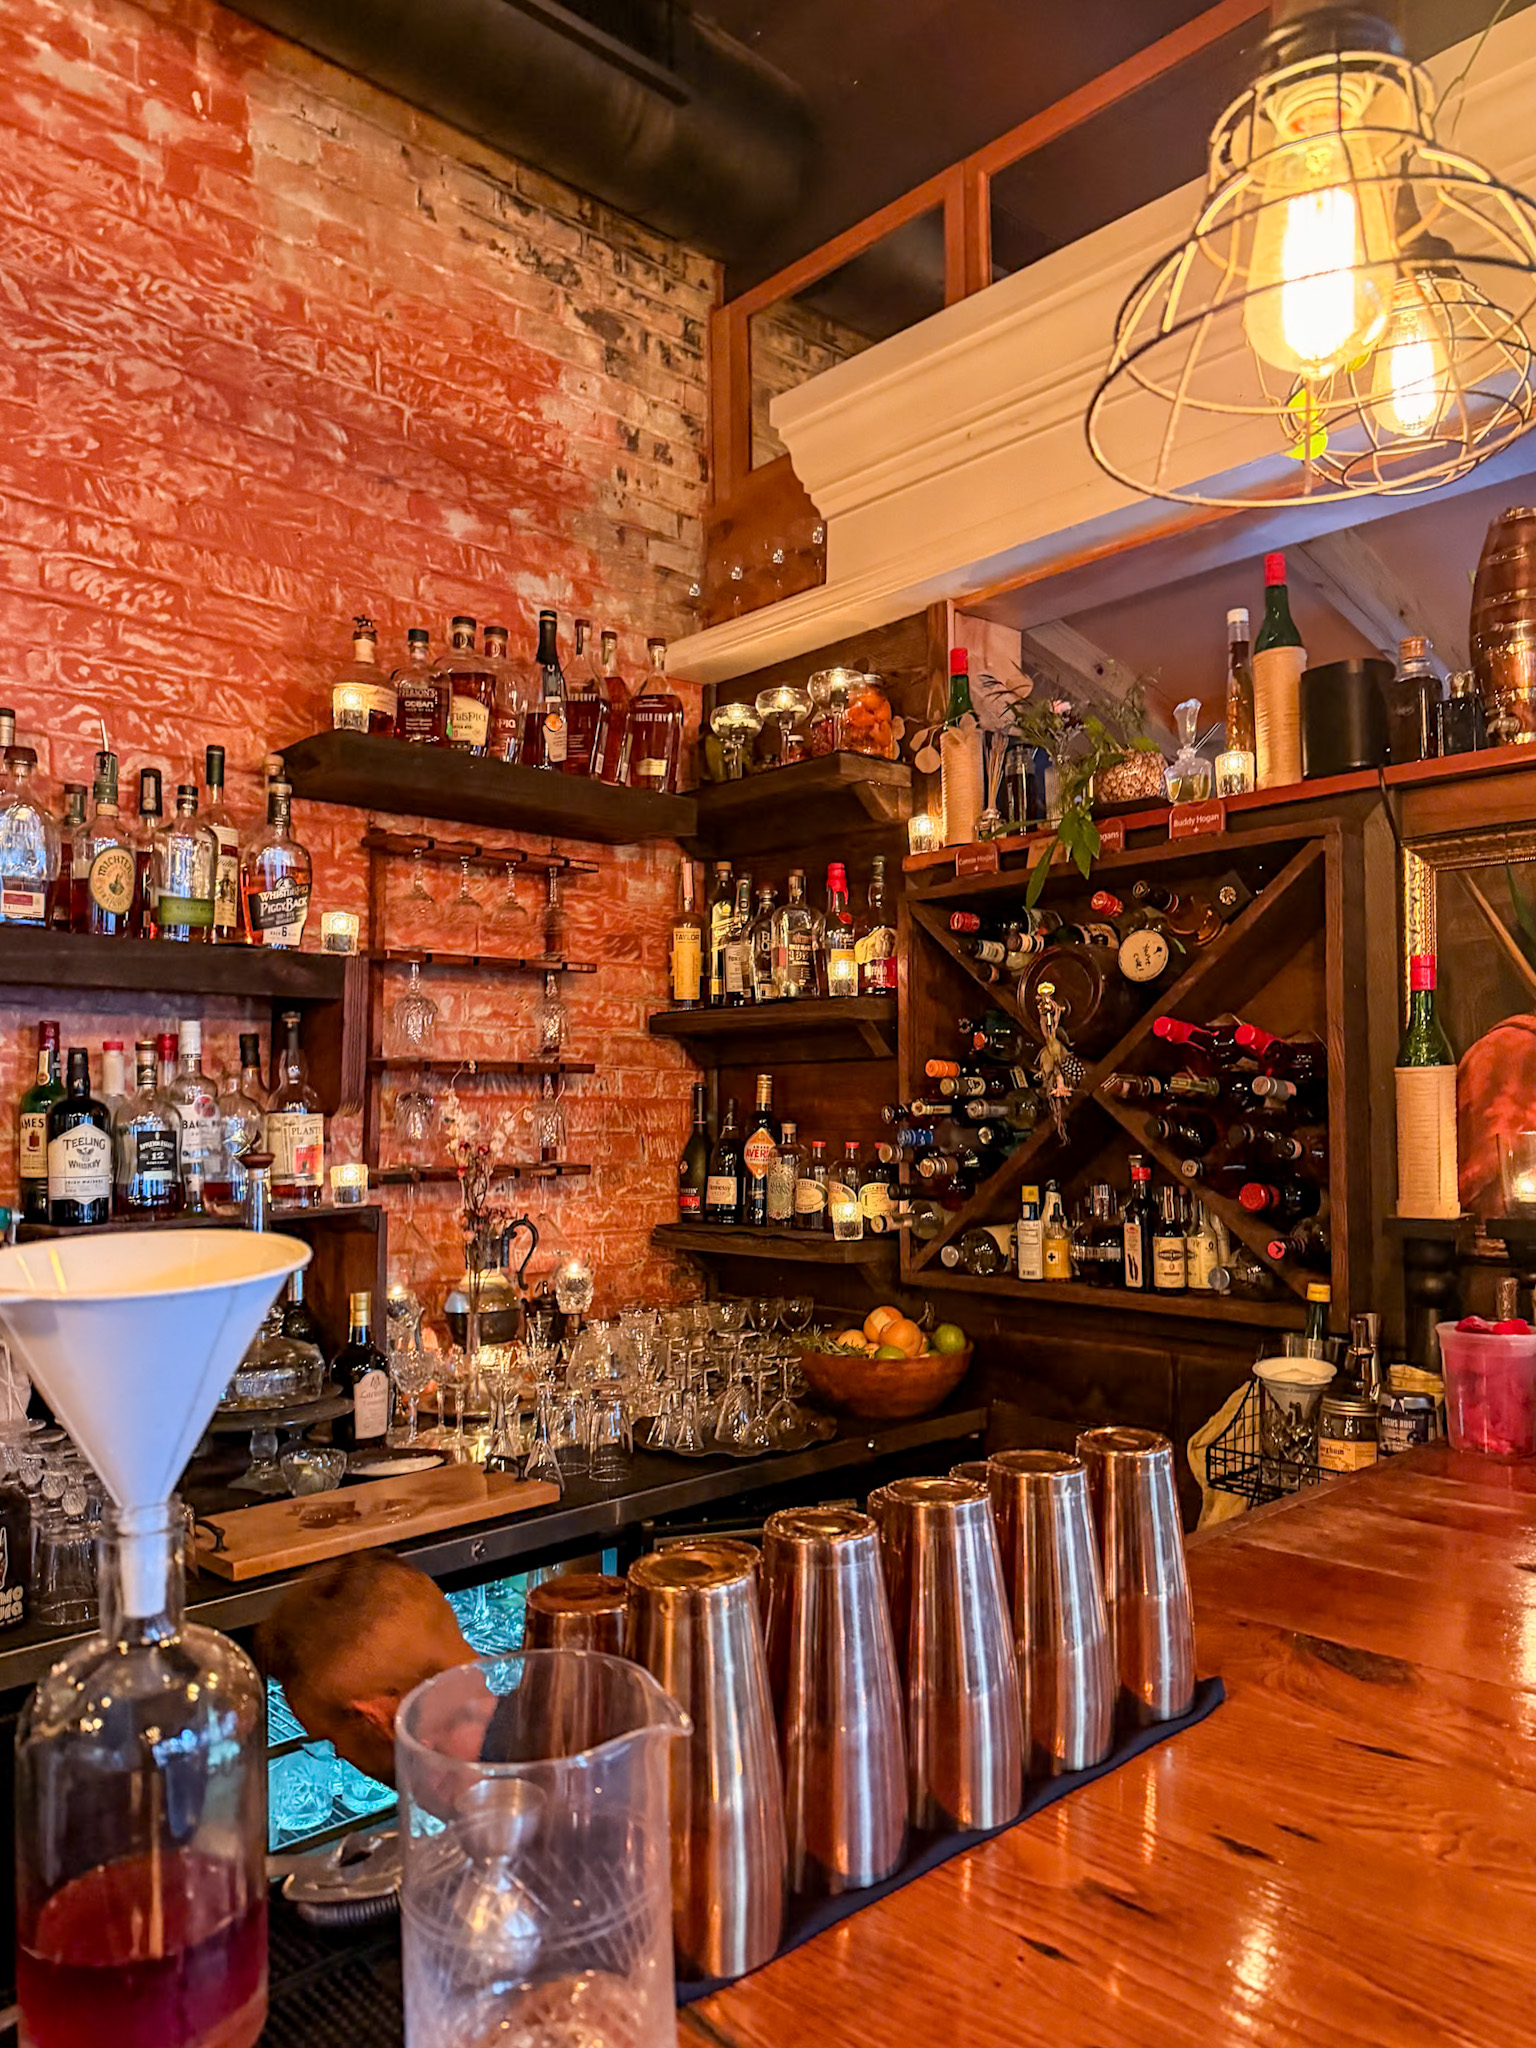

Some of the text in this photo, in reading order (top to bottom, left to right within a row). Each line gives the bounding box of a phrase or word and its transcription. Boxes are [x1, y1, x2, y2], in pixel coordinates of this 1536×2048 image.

[404, 700, 435, 708] OCEAN
[1173, 811, 1220, 829] Buddy Hogan
[281, 926, 288, 937] 6
[63, 1136, 106, 1151] TEELING
[151, 1152, 165, 1161] 12
[68, 1159, 102, 1170] WHISKEY
[1399, 1419, 1416, 1429] ROOT
